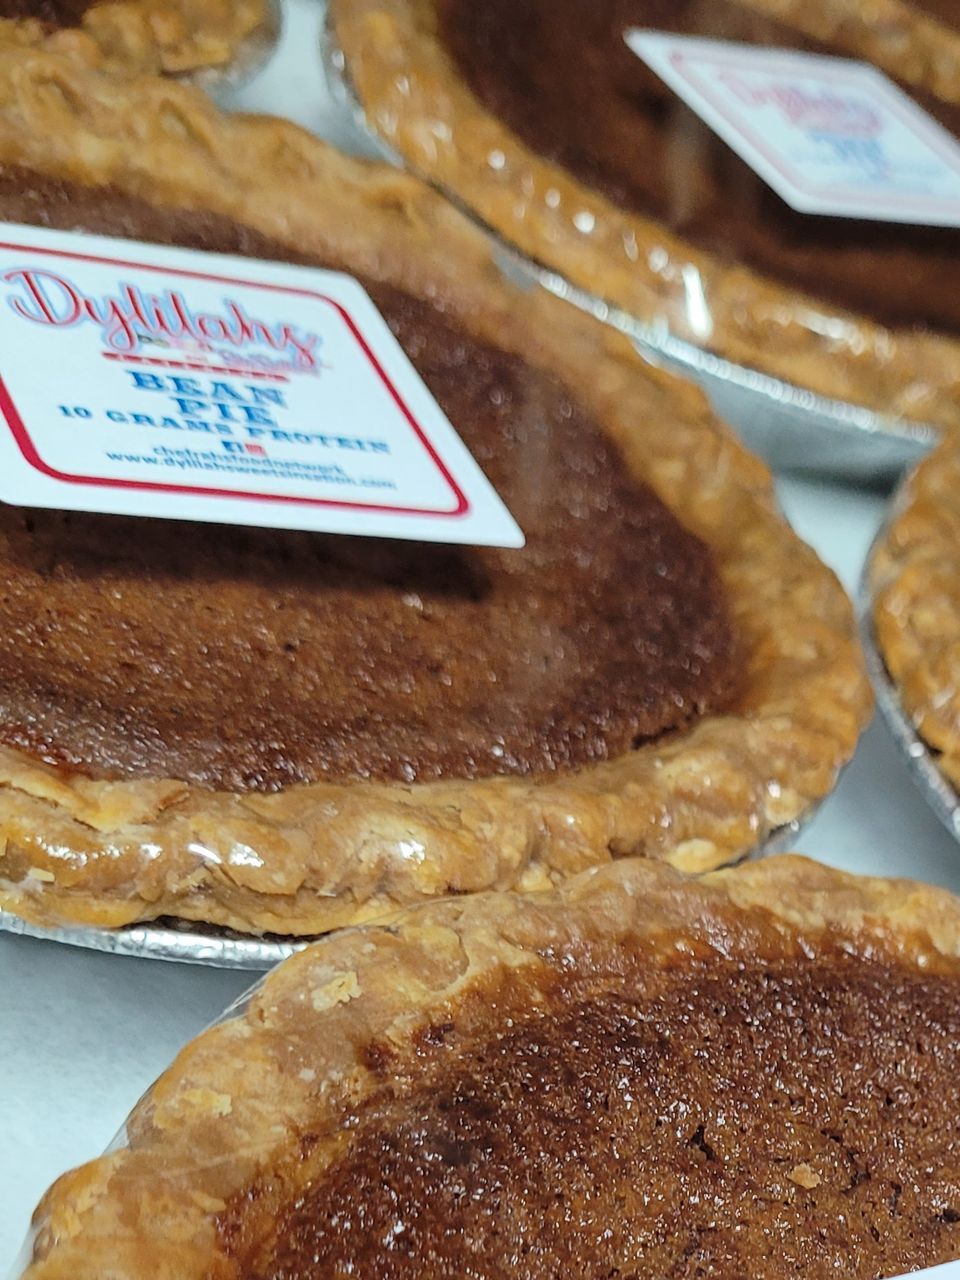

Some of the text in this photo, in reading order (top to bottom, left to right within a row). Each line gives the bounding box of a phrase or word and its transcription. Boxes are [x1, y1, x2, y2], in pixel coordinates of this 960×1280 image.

[3, 268, 320, 367] Dylilahs
[125, 369, 288, 407] BEAN
[57, 404, 393, 454] 10 GRAMS PROTEIN
[169, 396, 279, 428] PIE
